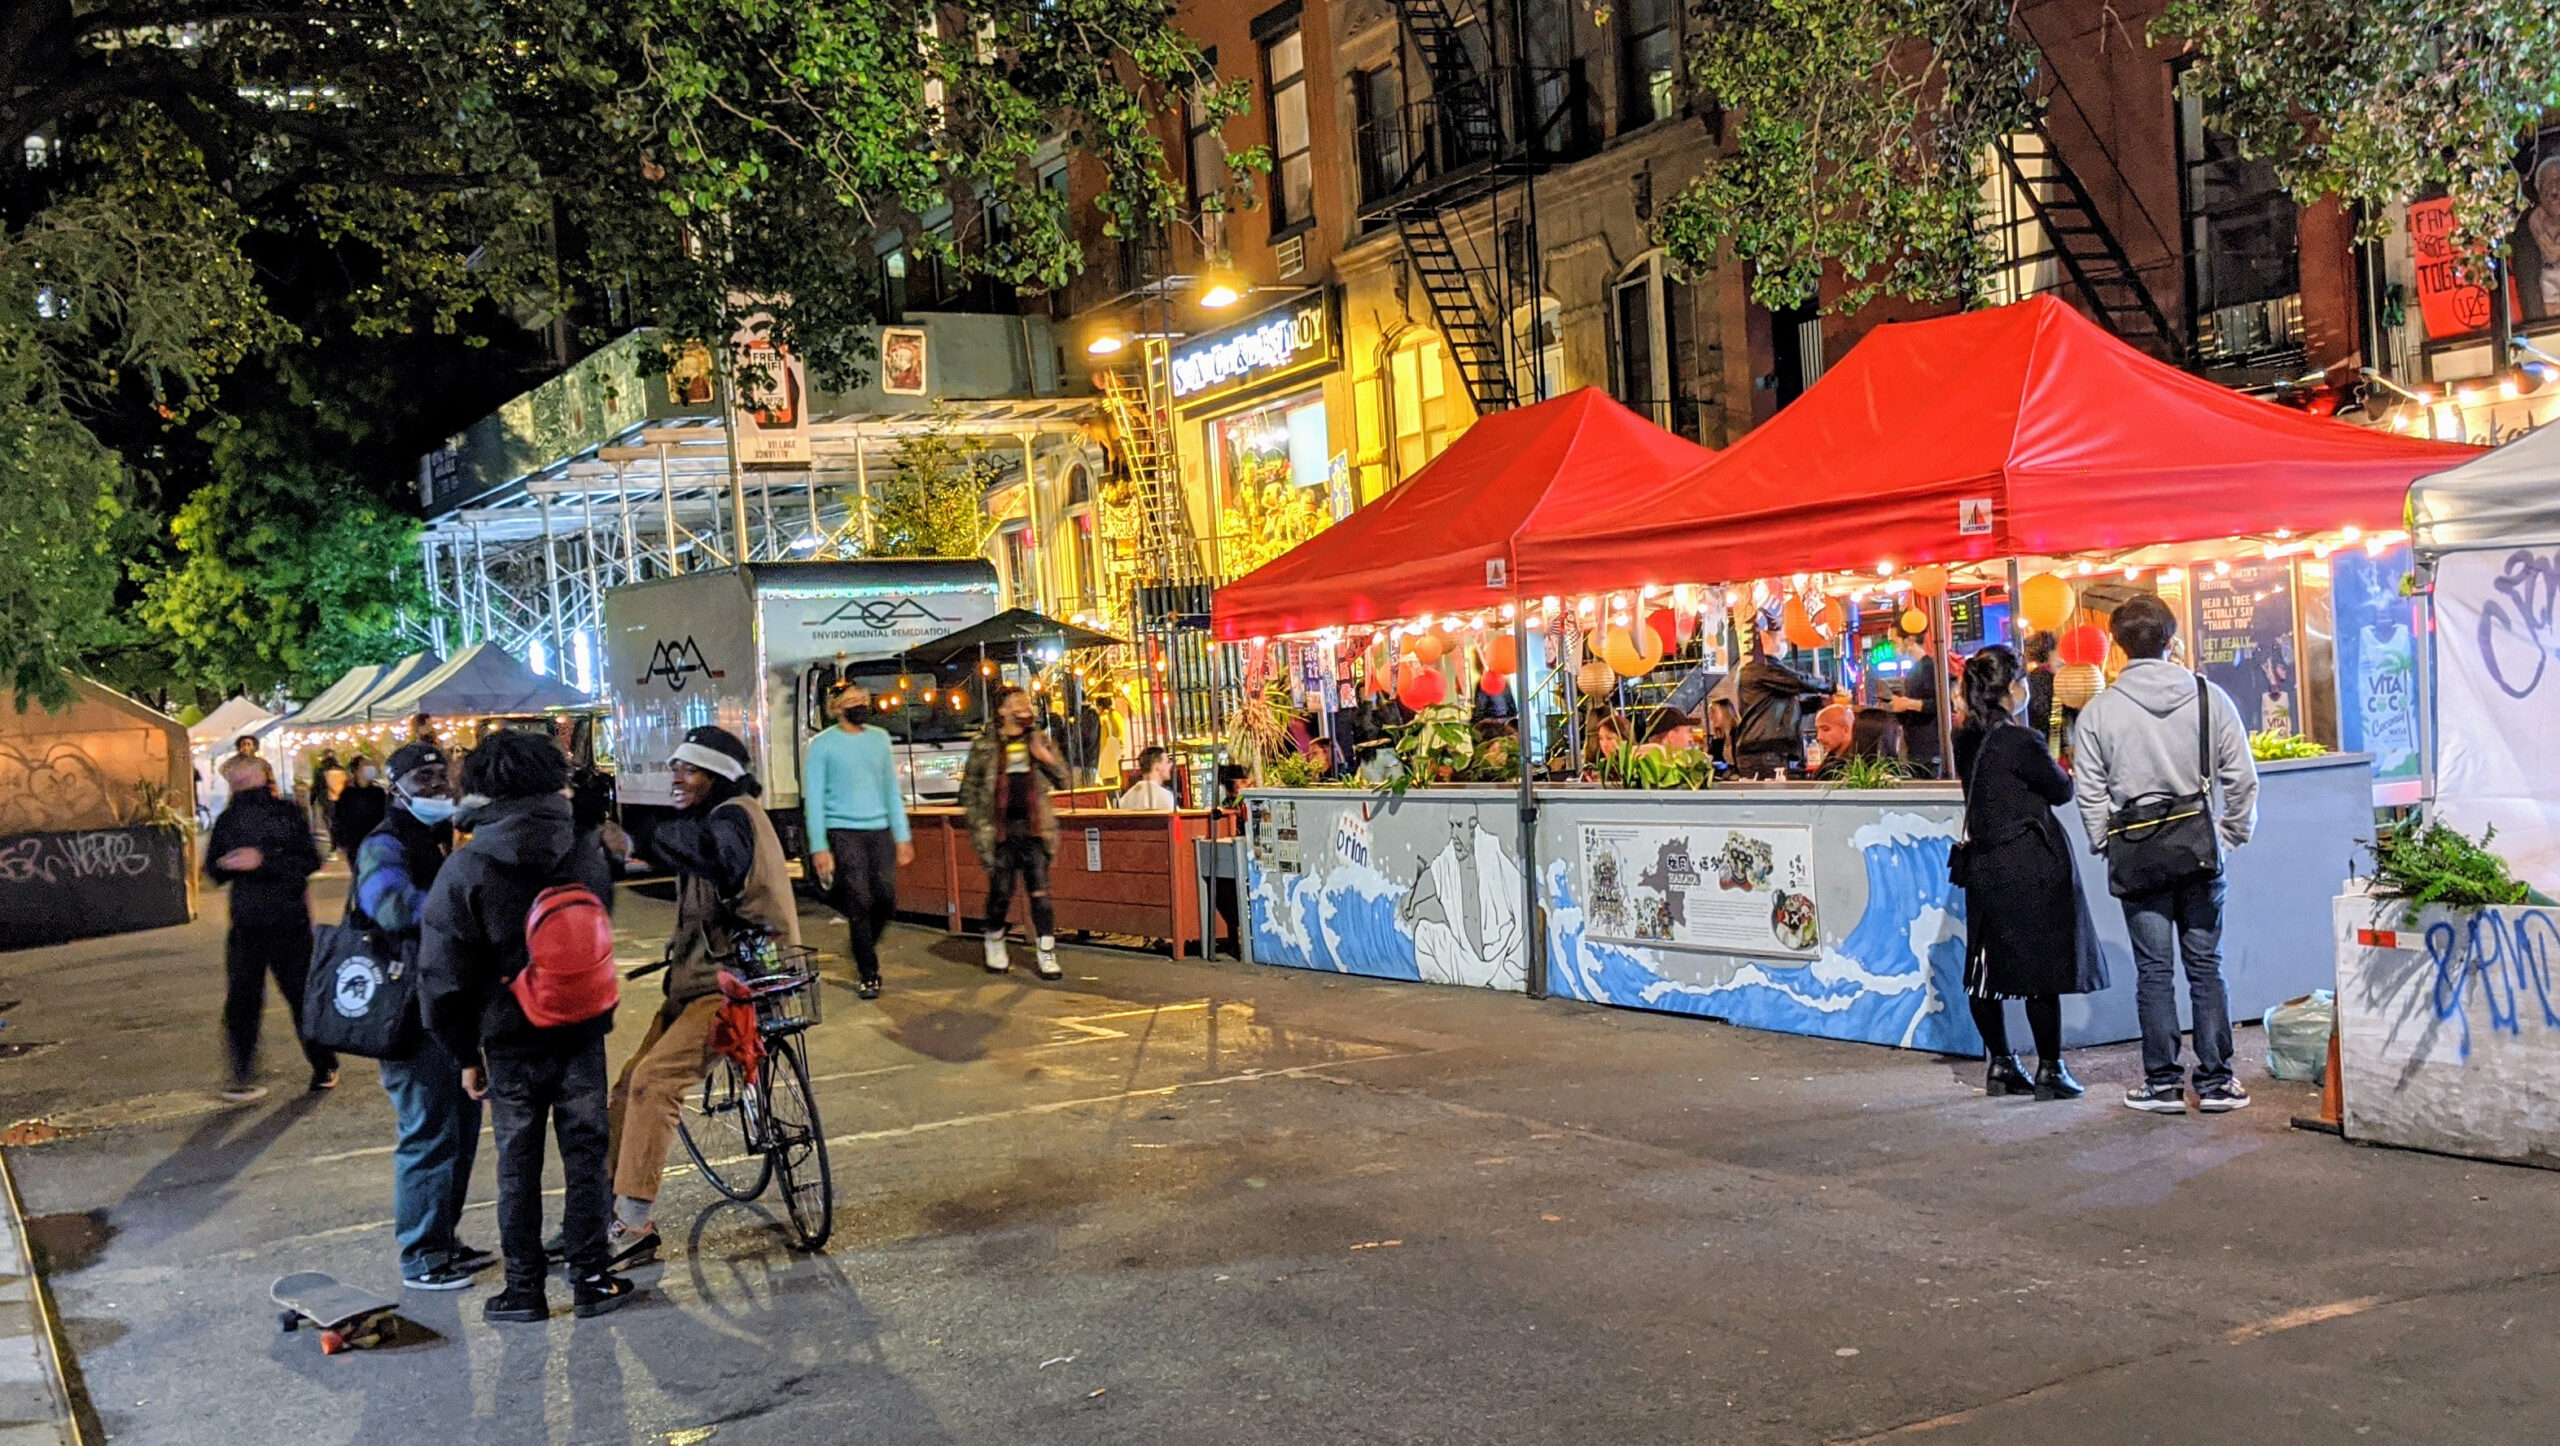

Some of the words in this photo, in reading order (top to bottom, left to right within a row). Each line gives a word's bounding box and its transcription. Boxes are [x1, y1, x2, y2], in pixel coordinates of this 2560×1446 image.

[2459, 296, 2489, 319] ICE
[768, 440, 796, 449] VILLAGE
[755, 450, 788, 459] ALLIANCE
[2202, 597, 2222, 608] HEAR
[2224, 597, 2230, 607] A
[2232, 595, 2251, 606] TREE
[2203, 608, 2237, 619] ACTUALLY
[2240, 606, 2254, 617] SAY
[812, 629, 888, 640] ENVIRONMENTAL
[891, 627, 950, 637] REMEDIATION
[2204, 639, 2219, 650] GET
[2221, 637, 2250, 649] REALLY
[2368, 673, 2403, 695] VITA
[2368, 695, 2409, 713] COCO
[2267, 718, 2285, 728] VITA
